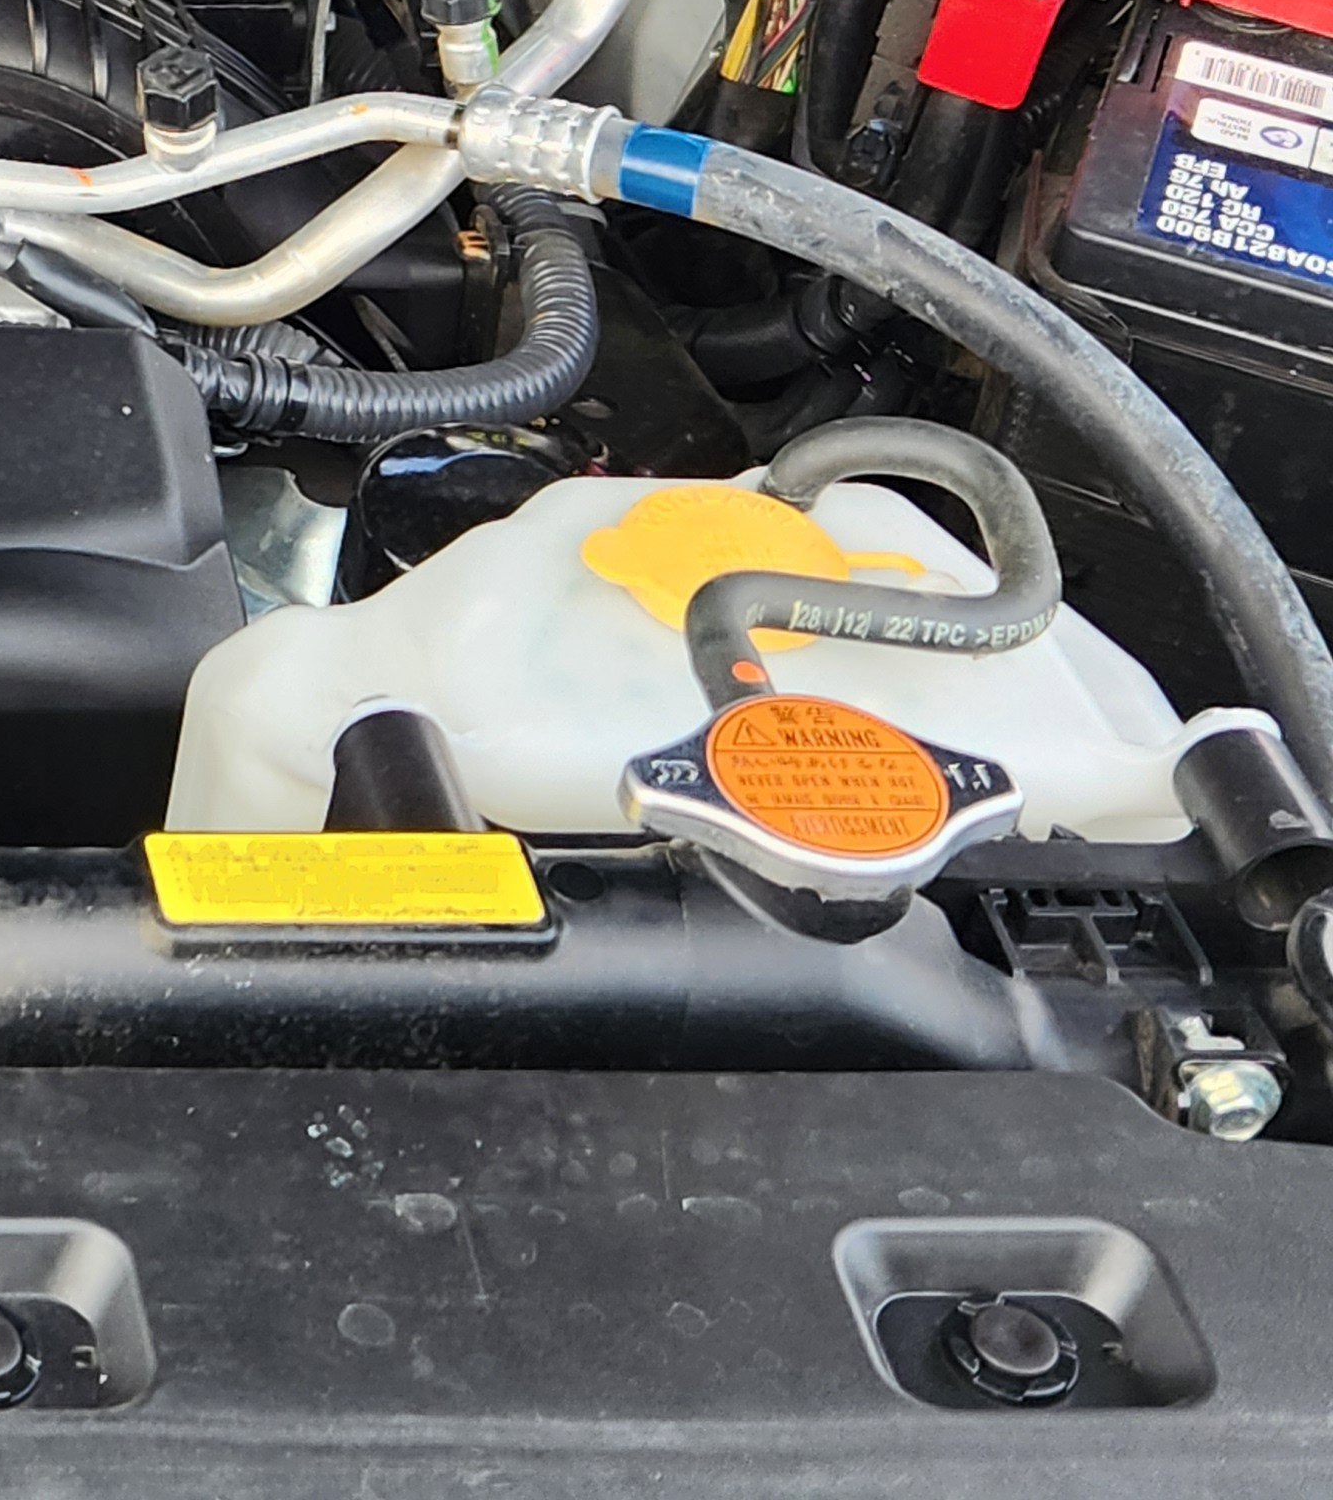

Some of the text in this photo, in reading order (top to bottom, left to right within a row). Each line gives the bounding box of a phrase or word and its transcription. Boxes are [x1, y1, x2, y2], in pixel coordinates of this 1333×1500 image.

[1174, 153, 1227, 180] EFB
[1165, 184, 1263, 222] RC 120
[1161, 200, 1275, 242] CCA 750
[921, 619, 966, 648] TPC
[778, 728, 881, 748] WARNING
